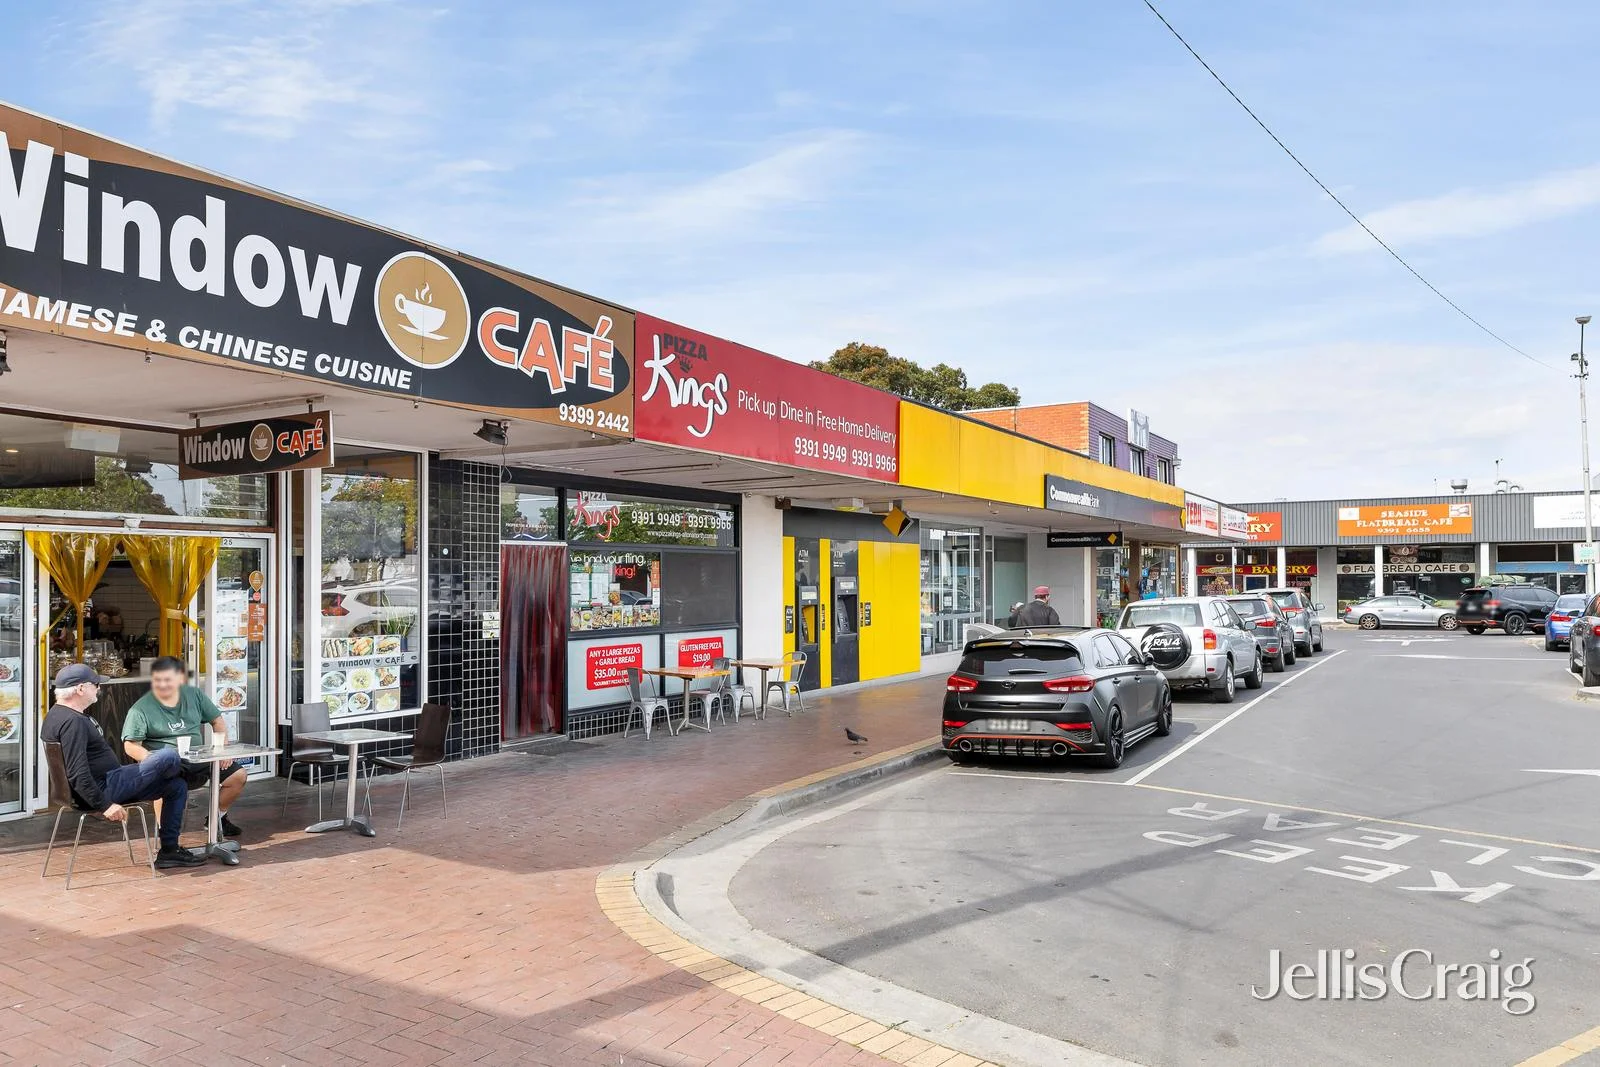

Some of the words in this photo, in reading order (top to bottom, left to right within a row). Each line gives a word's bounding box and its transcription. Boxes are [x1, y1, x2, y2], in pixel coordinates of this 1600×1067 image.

[477, 307, 615, 394] CAFÉ
[663, 332, 708, 361] PIZZA
[145, 319, 167, 343] &
[178, 325, 307, 371] CHINESE
[314, 353, 413, 390] CUISINE
[641, 333, 728, 438] Kings
[559, 402, 595, 426] 9399
[597, 411, 629, 432] 2442
[738, 389, 760, 413] Pick
[762, 400, 777, 420] up
[780, 400, 803, 423] Dine
[805, 407, 814, 425] in
[816, 410, 837, 431] Free
[838, 415, 863, 437] Home
[864, 423, 897, 448] Delivery
[183, 432, 246, 465] Window
[276, 418, 324, 458] CAFÉ
[794, 436, 820, 458] 9391
[822, 442, 847, 463] 9949
[852, 449, 873, 468] 9391
[875, 454, 897, 473] 9966
[582, 490, 607, 501] PIZZA
[570, 490, 620, 539] Kings
[631, 510, 655, 525] 9391
[657, 512, 680, 526] 9949
[688, 515, 708, 528] 9391
[711, 517, 731, 530] 9966
[1381, 509, 1428, 518] SEASIDE
[1356, 518, 1419, 528] FLATBREAD
[583, 554, 602, 563] had
[604, 555, 625, 565] your
[614, 564, 636, 579] king!
[1354, 564, 1421, 573] FLABREAD
[1425, 564, 1457, 573] CAFE
[589, 650, 601, 658] ANY
[605, 648, 623, 657] LARGE
[623, 646, 641, 655] PIZZAS
[680, 643, 699, 652] GLUTEN
[698, 642, 709, 650] FREE
[709, 641, 722, 649] PIZZA
[338, 658, 371, 668] Window
[599, 657, 618, 666] GARLIC
[618, 655, 636, 664] BREAD
[692, 652, 711, 663] $19.00
[594, 667, 617, 680] $35.00
[1142, 829, 1515, 903] KEEP
